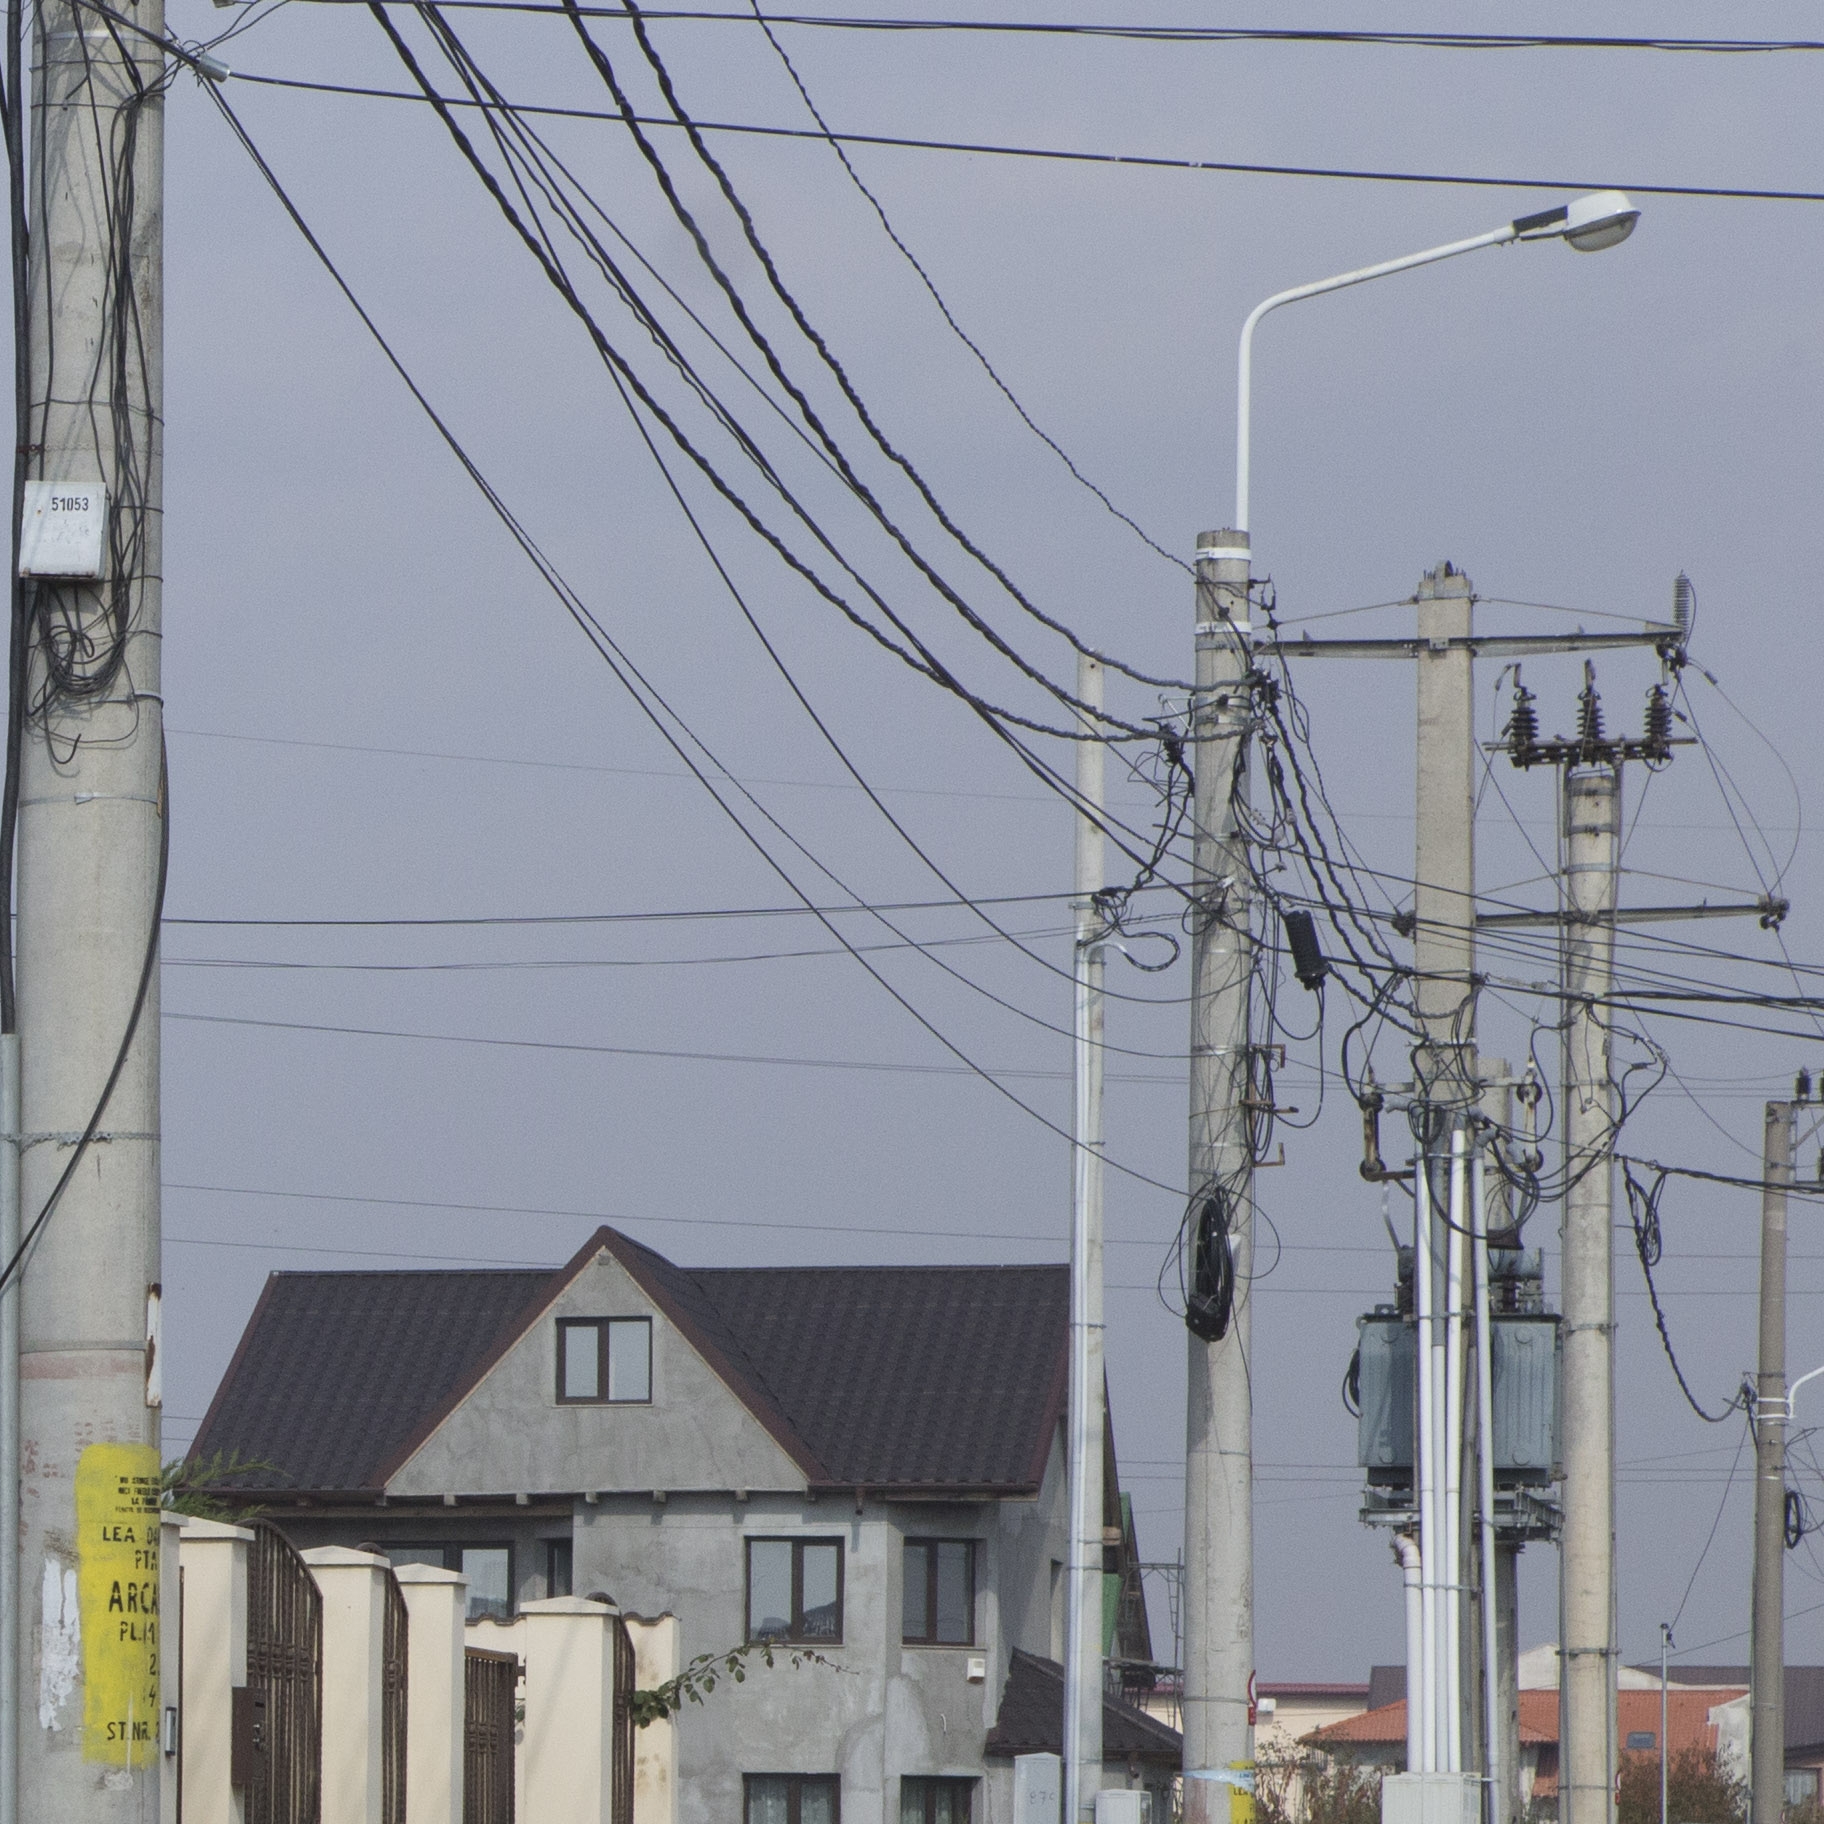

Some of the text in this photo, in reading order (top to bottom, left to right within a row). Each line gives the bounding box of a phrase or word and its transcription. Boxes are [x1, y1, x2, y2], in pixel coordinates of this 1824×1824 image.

[52, 497, 89, 511] 51053
[103, 1526, 135, 1543] LEA
[135, 1550, 158, 1571] PTA
